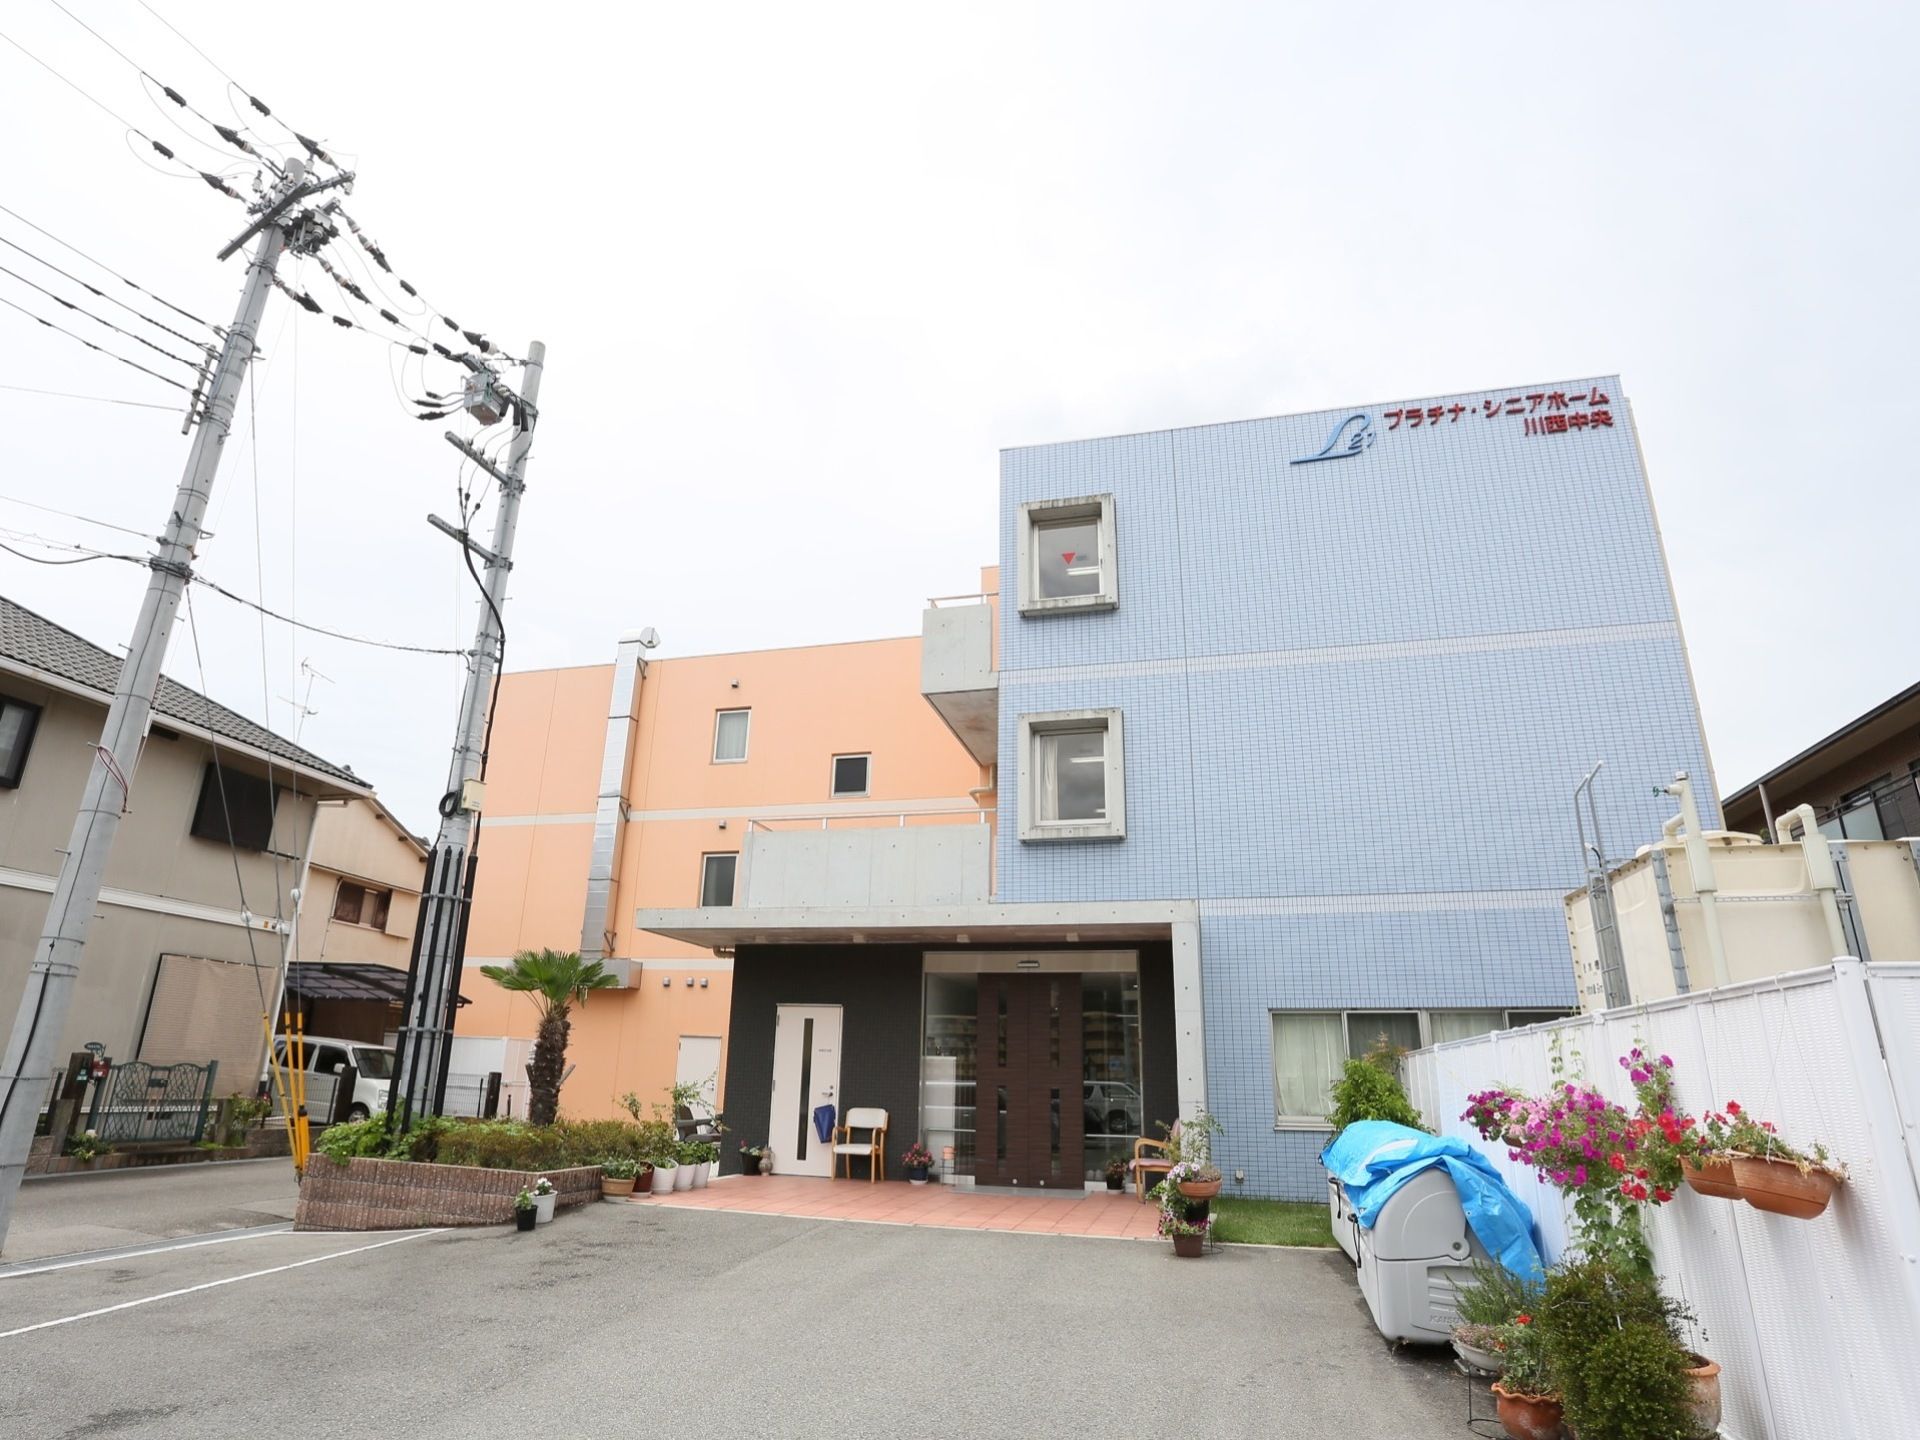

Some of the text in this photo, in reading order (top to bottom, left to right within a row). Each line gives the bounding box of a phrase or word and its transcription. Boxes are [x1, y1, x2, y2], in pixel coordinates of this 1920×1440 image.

[1384, 387, 1610, 430] プラチナ・シニアホーム
[1524, 410, 1614, 436] 川西中央
